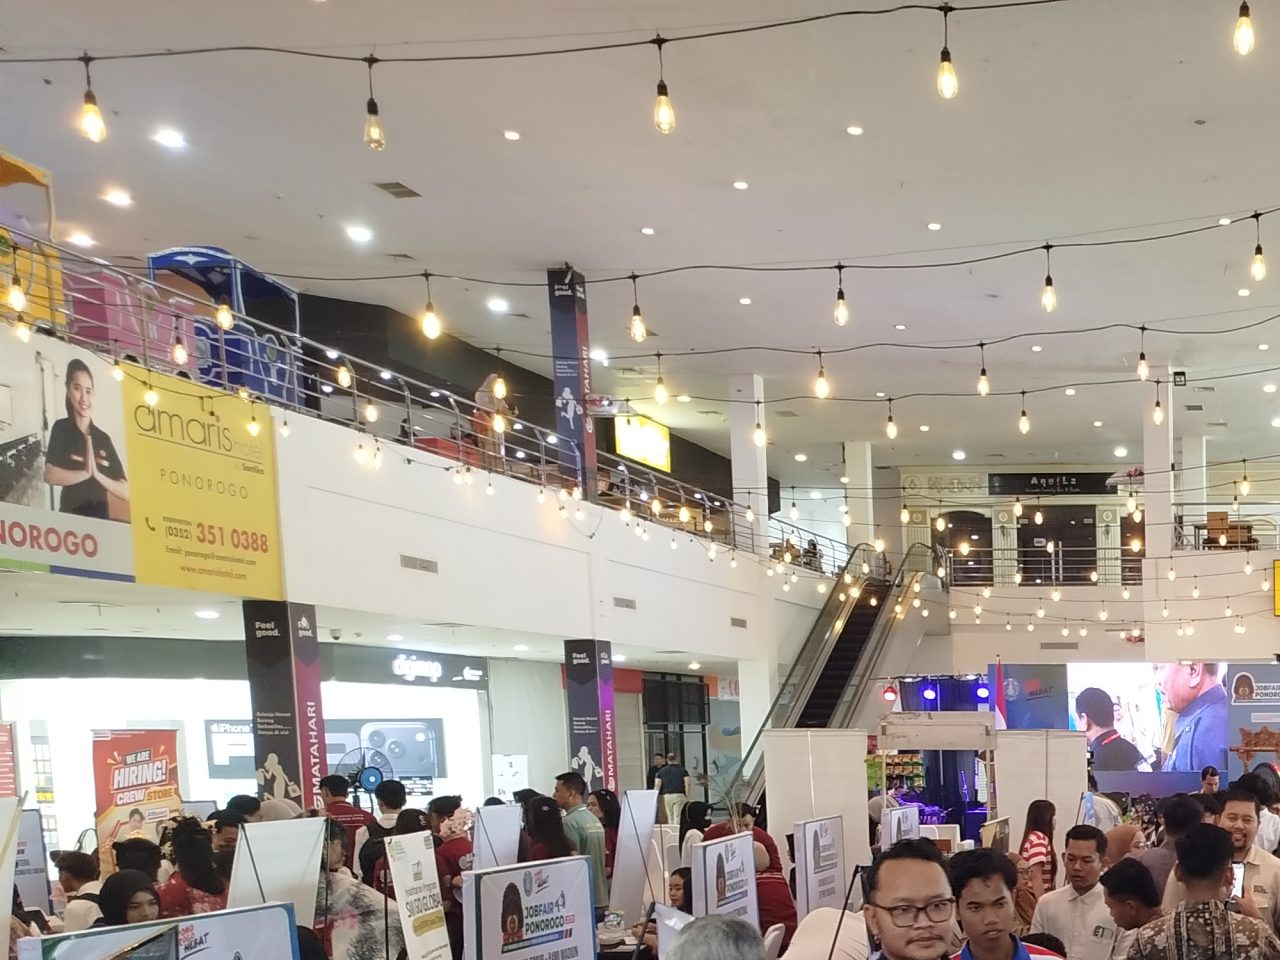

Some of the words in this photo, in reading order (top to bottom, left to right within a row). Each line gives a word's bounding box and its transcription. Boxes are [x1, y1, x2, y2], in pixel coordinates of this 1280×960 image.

[134, 404, 233, 452] amaris
[160, 468, 248, 499] PONOROGO
[165, 525, 192, 542] (0352)
[196, 522, 225, 546] 351
[230, 528, 269, 553] 0388
[255, 621, 275, 630] Feel
[255, 628, 281, 638] good.
[572, 657, 590, 665] good.
[306, 701, 323, 791] MATAHARI
[604, 710, 615, 776] MATAHARI
[126, 753, 136, 764] WE
[137, 751, 151, 763] ARE
[113, 760, 167, 790] HIRING!
[116, 788, 146, 805] CREW
[147, 787, 174, 801] STORE
[524, 902, 554, 919] JOBFAIR
[525, 915, 564, 935] PONOROGO
